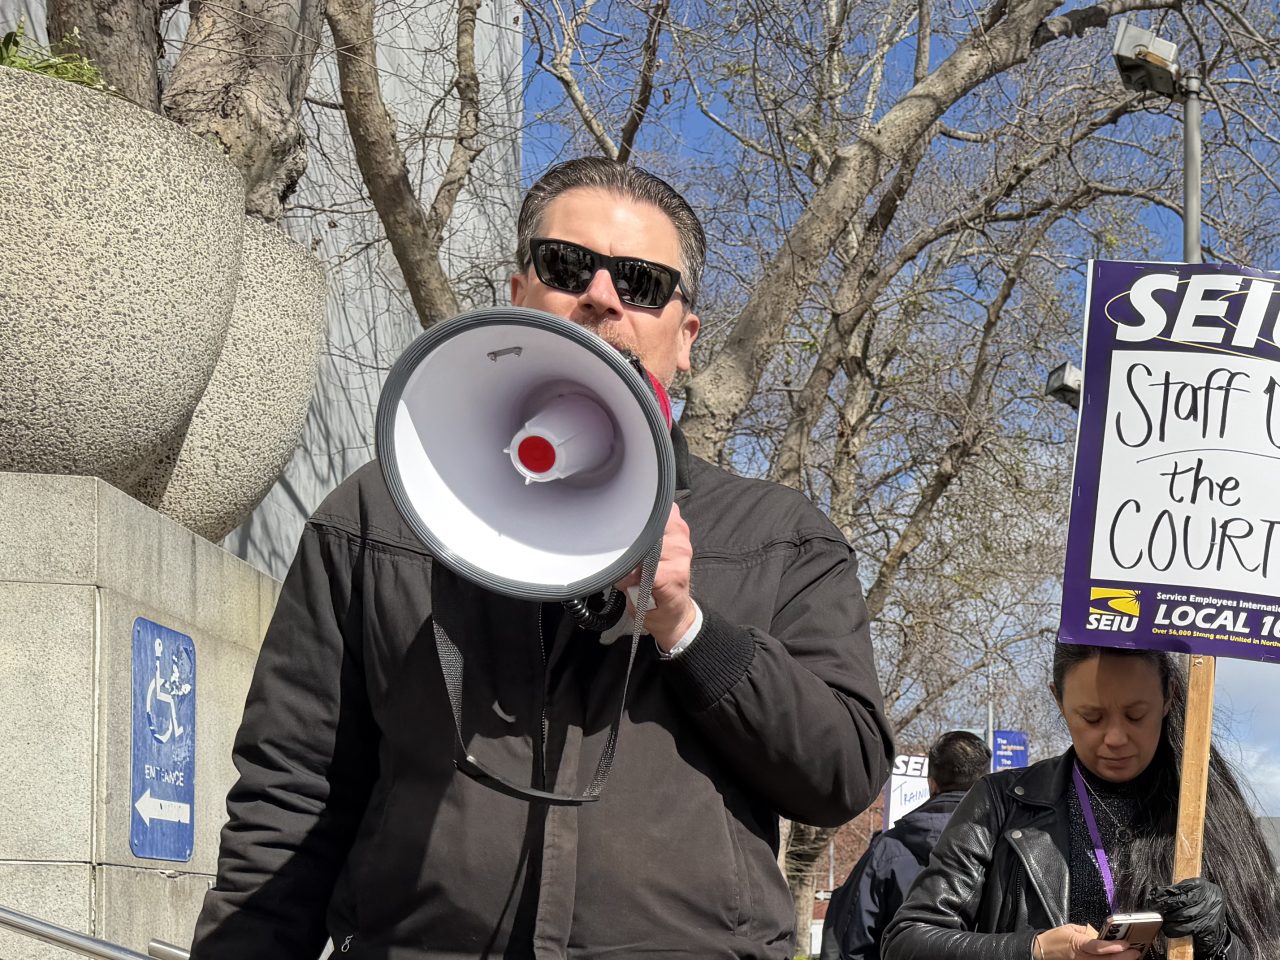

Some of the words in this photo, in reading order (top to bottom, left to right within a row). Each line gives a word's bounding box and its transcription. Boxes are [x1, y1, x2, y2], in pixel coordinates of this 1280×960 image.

[1115, 362, 1251, 448] Staff
[1160, 458, 1241, 506] the
[1156, 592, 1187, 602] Service
[1189, 594, 1237, 607] Employees
[1086, 614, 1139, 632] SEIU
[1154, 604, 1250, 633] LOCAL
[1193, 631, 1215, 640] Strong
[1229, 635, 1251, 644] United
[892, 754, 929, 777] SEI
